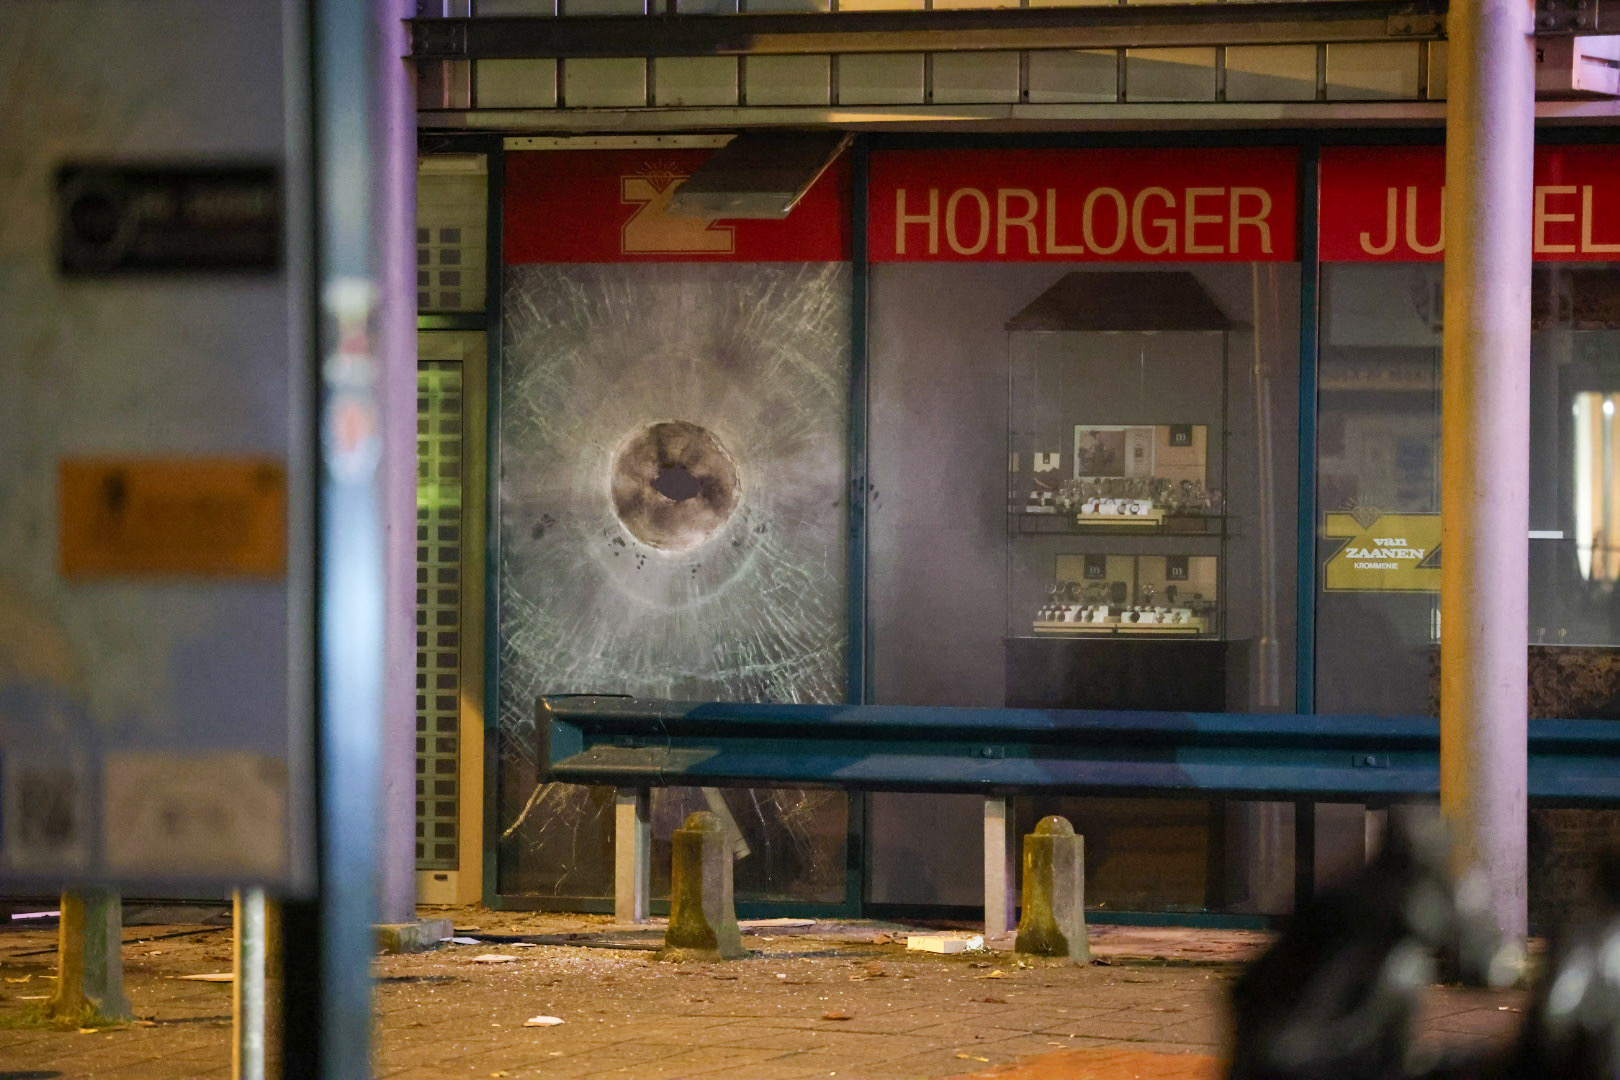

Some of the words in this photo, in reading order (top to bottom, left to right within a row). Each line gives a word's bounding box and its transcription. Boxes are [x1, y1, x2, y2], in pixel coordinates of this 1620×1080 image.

[895, 186, 1274, 256] HORLOGER
[1359, 184, 1620, 256] JUEL
[1345, 548, 1425, 559] ZAANEN
[1354, 562, 1399, 570] KROMMENIE
